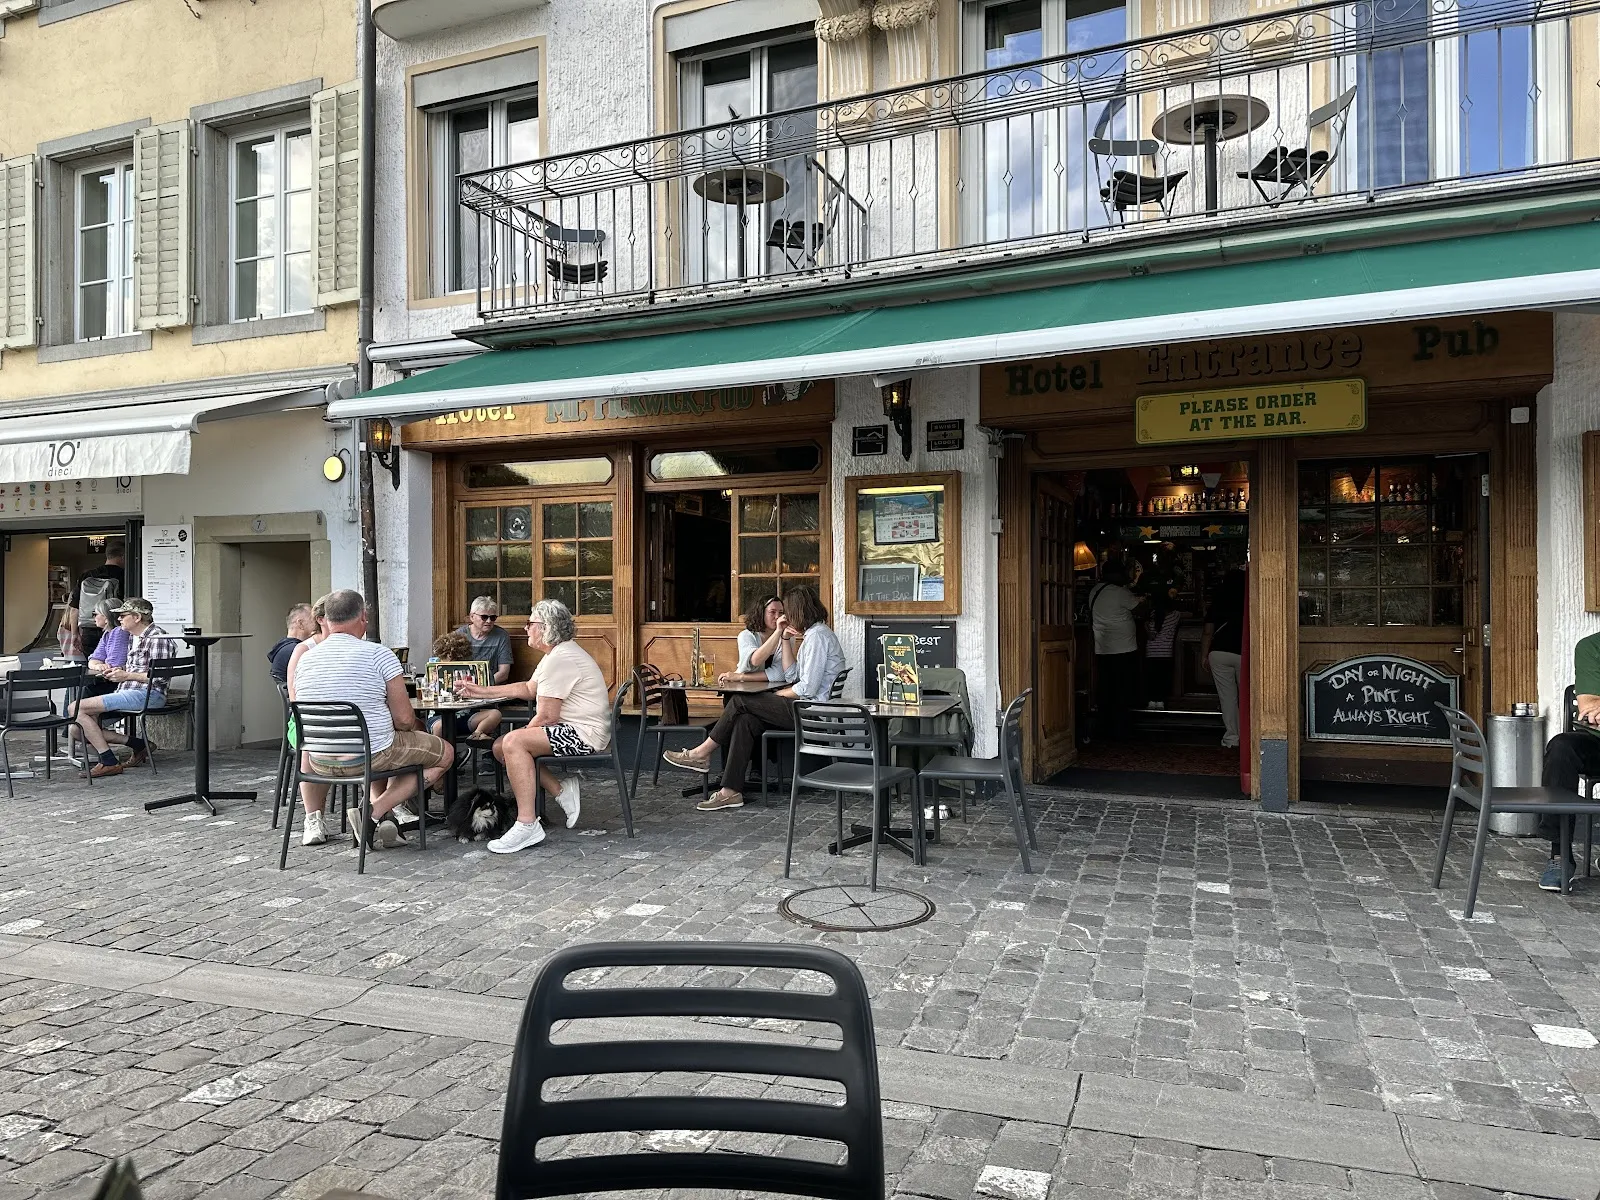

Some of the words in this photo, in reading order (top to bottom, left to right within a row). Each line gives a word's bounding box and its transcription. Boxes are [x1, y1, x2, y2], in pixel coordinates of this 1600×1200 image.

[1412, 320, 1498, 360] Pub
[1137, 334, 1362, 384] Entrance
[1005, 360, 1103, 395] Hotel
[1180, 397, 1248, 415] PLEASE
[1256, 392, 1317, 409] ORDER
[1189, 417, 1212, 432] AT
[1220, 414, 1256, 430] THE
[1264, 411, 1306, 427] BAR.
[47, 466, 73, 477] dieci
[256, 520, 261, 529] 7
[89, 539, 105, 547] HERE
[865, 573, 890, 584] HOTEL
[892, 572, 910, 584] INFO
[864, 592, 873, 601] AT
[875, 592, 889, 601] THE
[892, 590, 910, 601] BAR
[1327, 665, 1364, 689] DAY
[1367, 669, 1379, 677] OR
[1382, 663, 1435, 690] NIGHT
[1361, 685, 1400, 704] PINT
[1404, 693, 1414, 702] IS
[1332, 707, 1382, 726] ALWAYS
[1385, 706, 1431, 725] RIGHT
